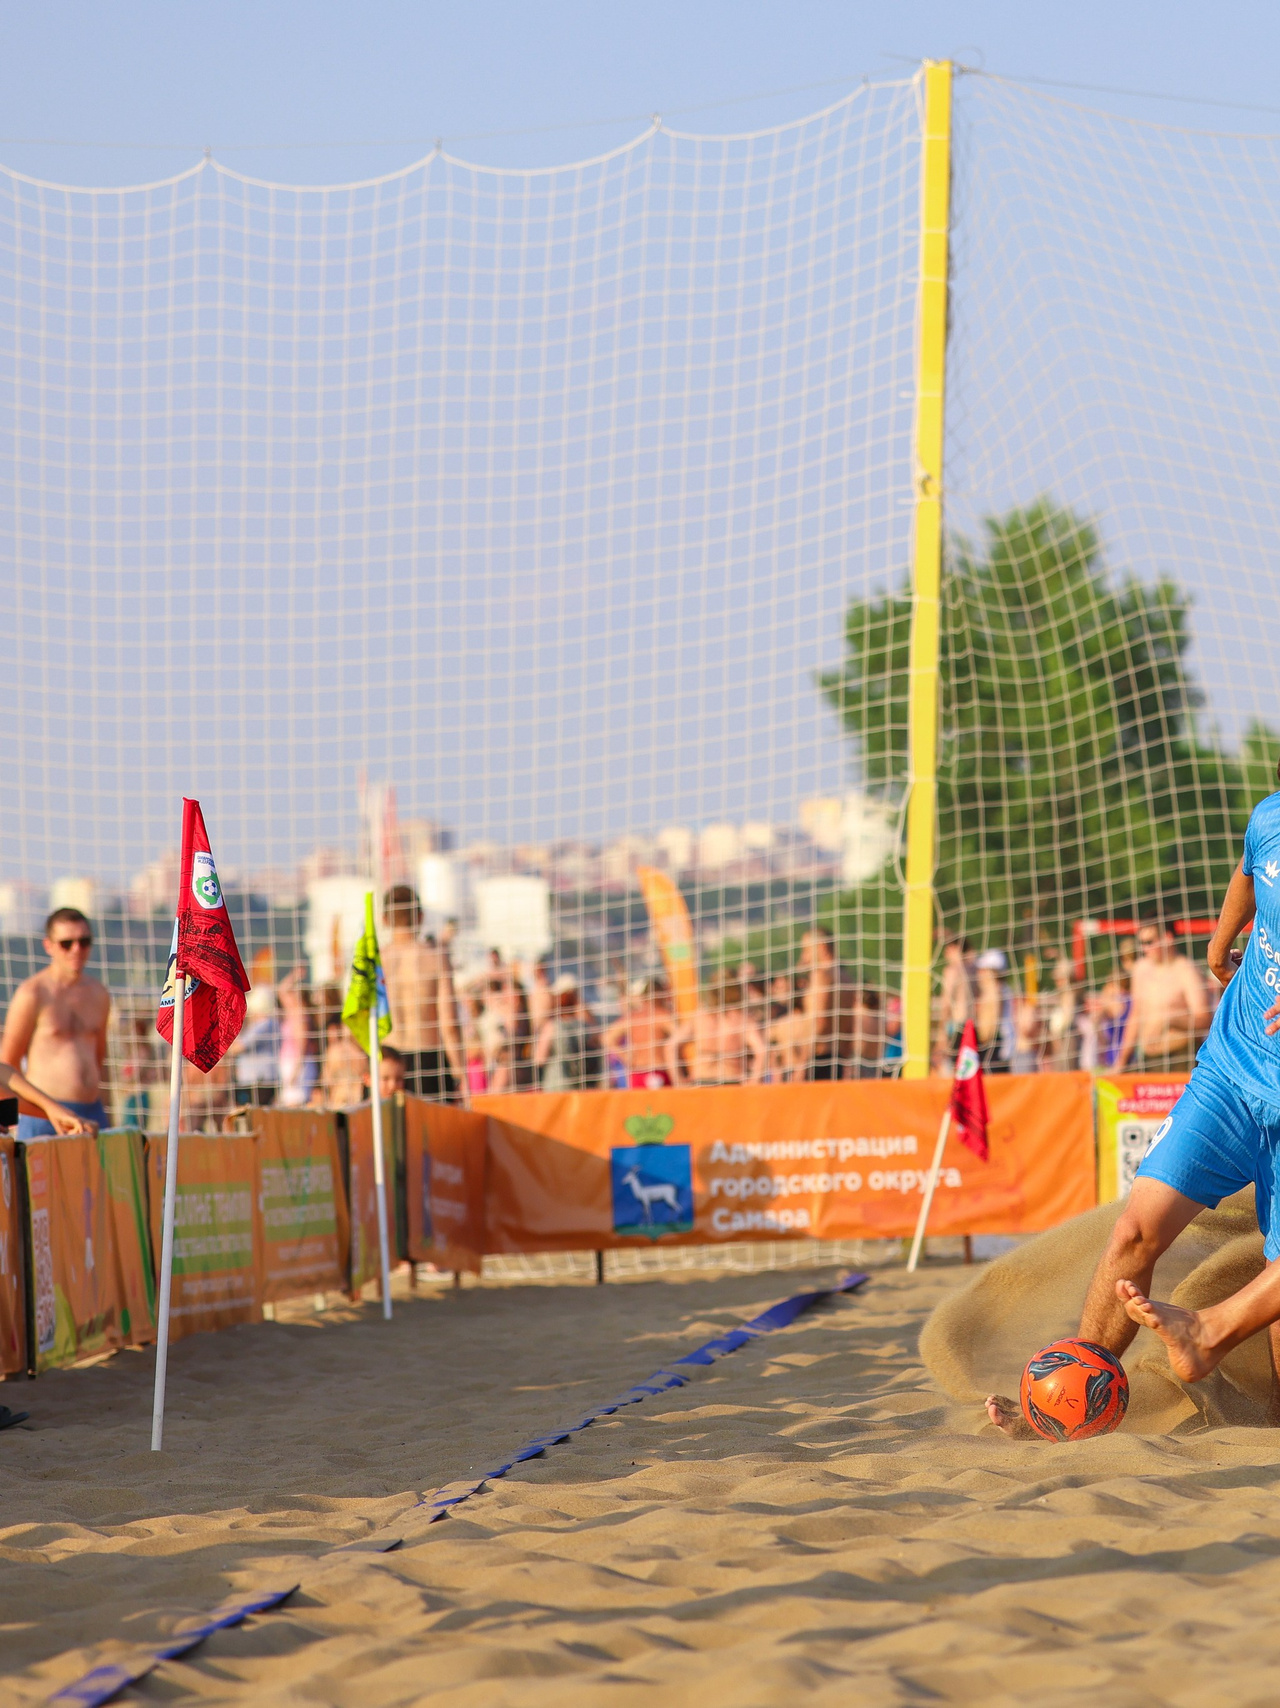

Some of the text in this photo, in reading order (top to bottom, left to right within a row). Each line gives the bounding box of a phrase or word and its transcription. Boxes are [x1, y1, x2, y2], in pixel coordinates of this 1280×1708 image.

[710, 1135, 918, 1163] Администрация
[710, 1171, 862, 1198] городского
[712, 1208, 810, 1232] Самара
